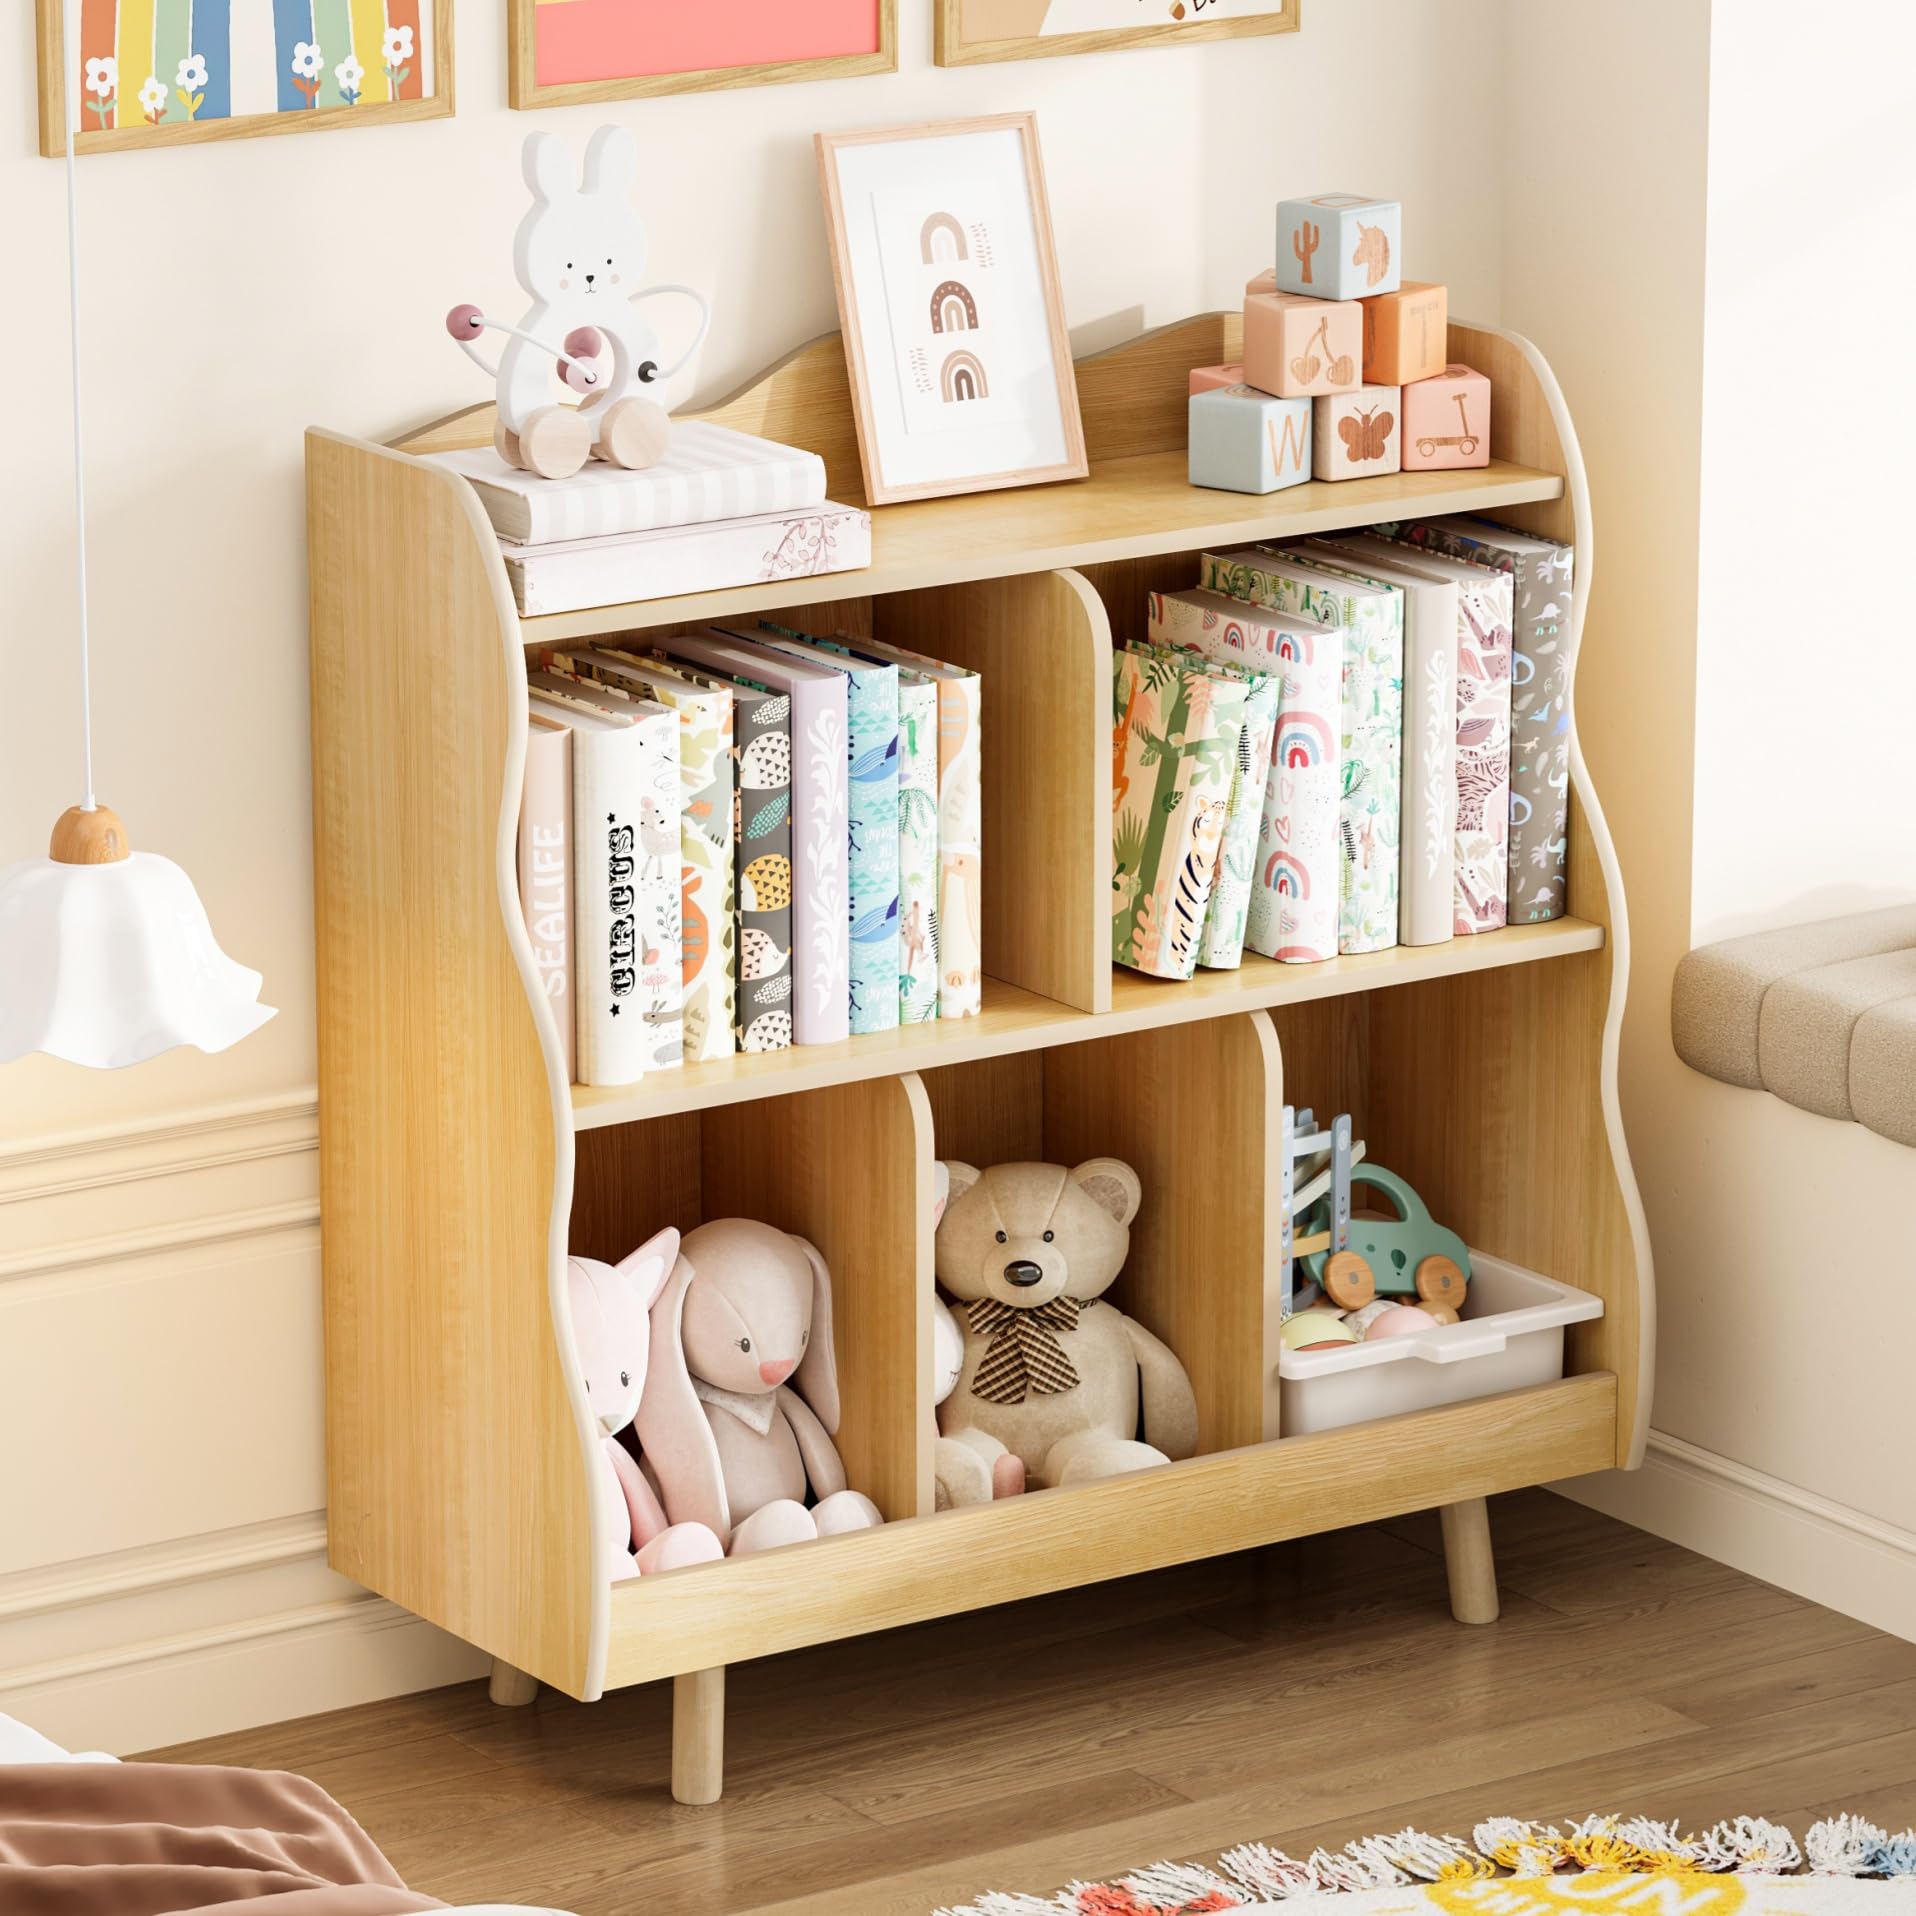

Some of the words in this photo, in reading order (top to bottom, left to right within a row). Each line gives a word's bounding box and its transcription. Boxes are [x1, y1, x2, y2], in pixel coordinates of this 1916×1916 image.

[1410, 301, 1439, 369] T
[1267, 409, 1309, 477] W
[608, 825, 635, 997] CIRCUS
